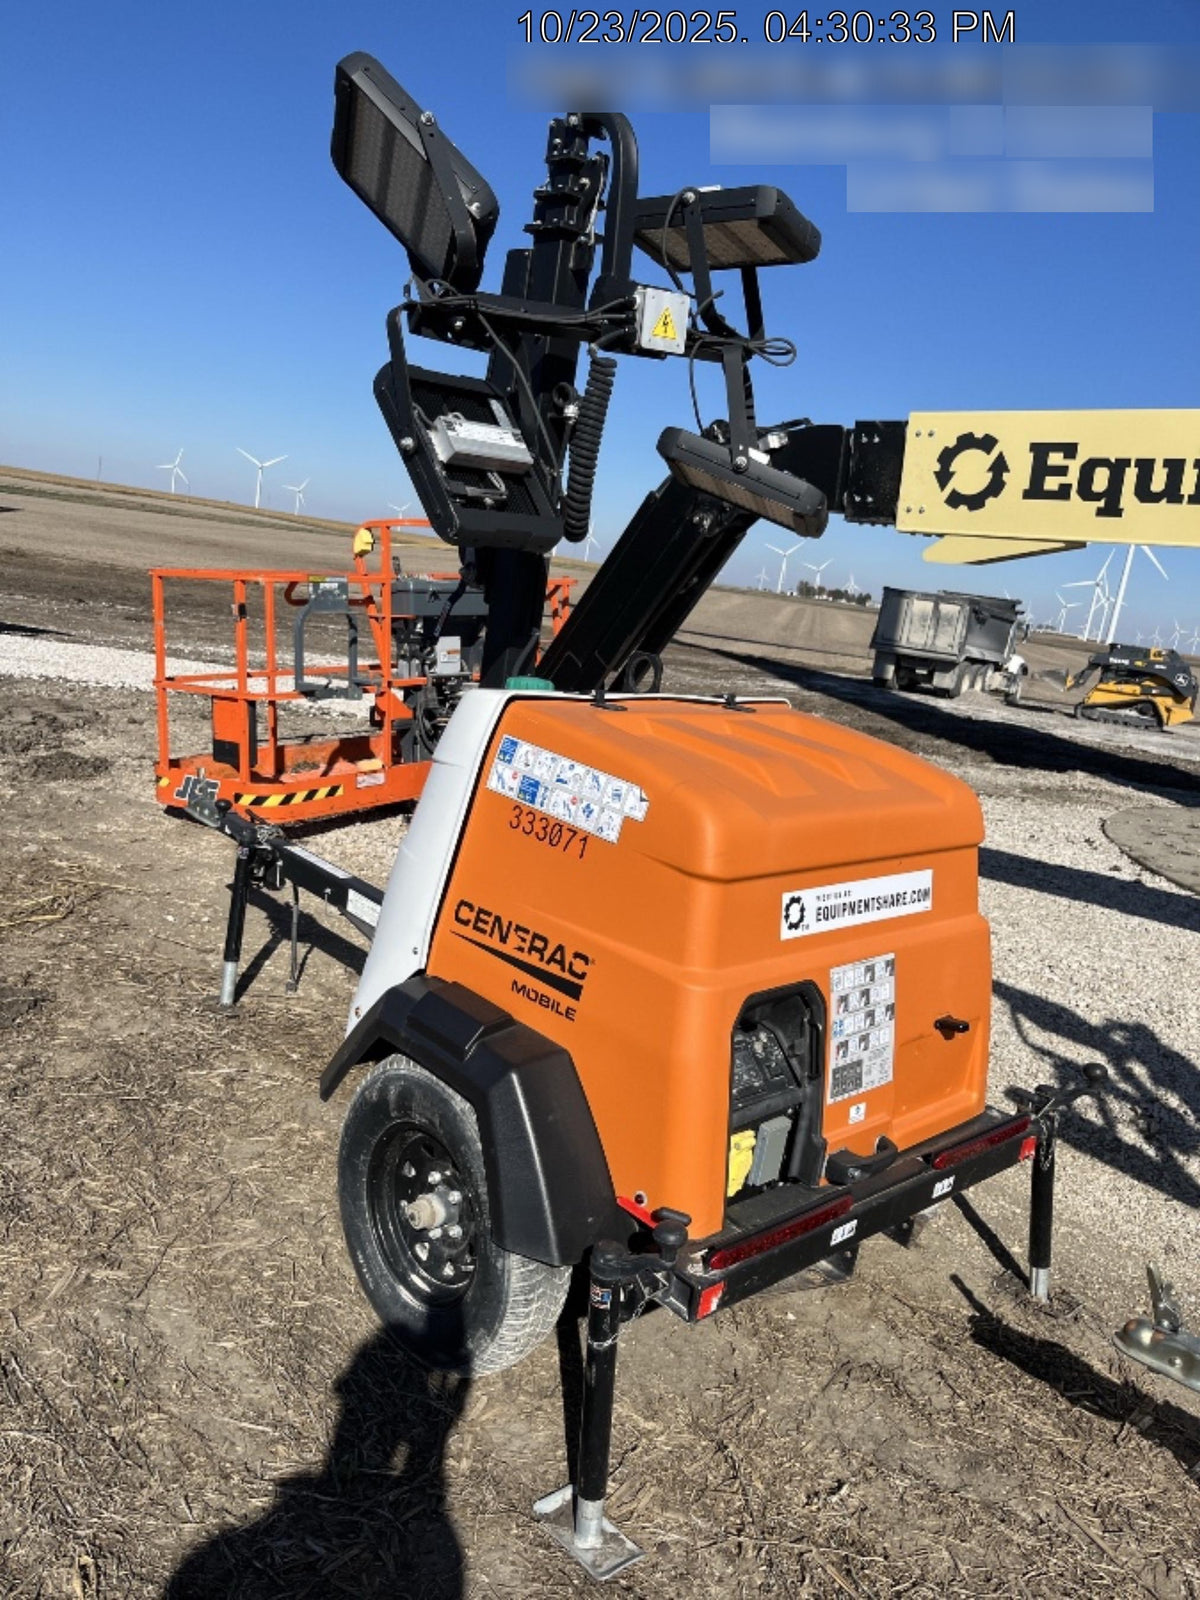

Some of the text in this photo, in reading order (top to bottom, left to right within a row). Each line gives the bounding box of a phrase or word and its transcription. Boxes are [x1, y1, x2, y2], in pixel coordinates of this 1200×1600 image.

[509, 805, 589, 859] 333071
[816, 887, 931, 922] EQUIPMENTSHARE.COM
[511, 979, 577, 1021] MOBILE
